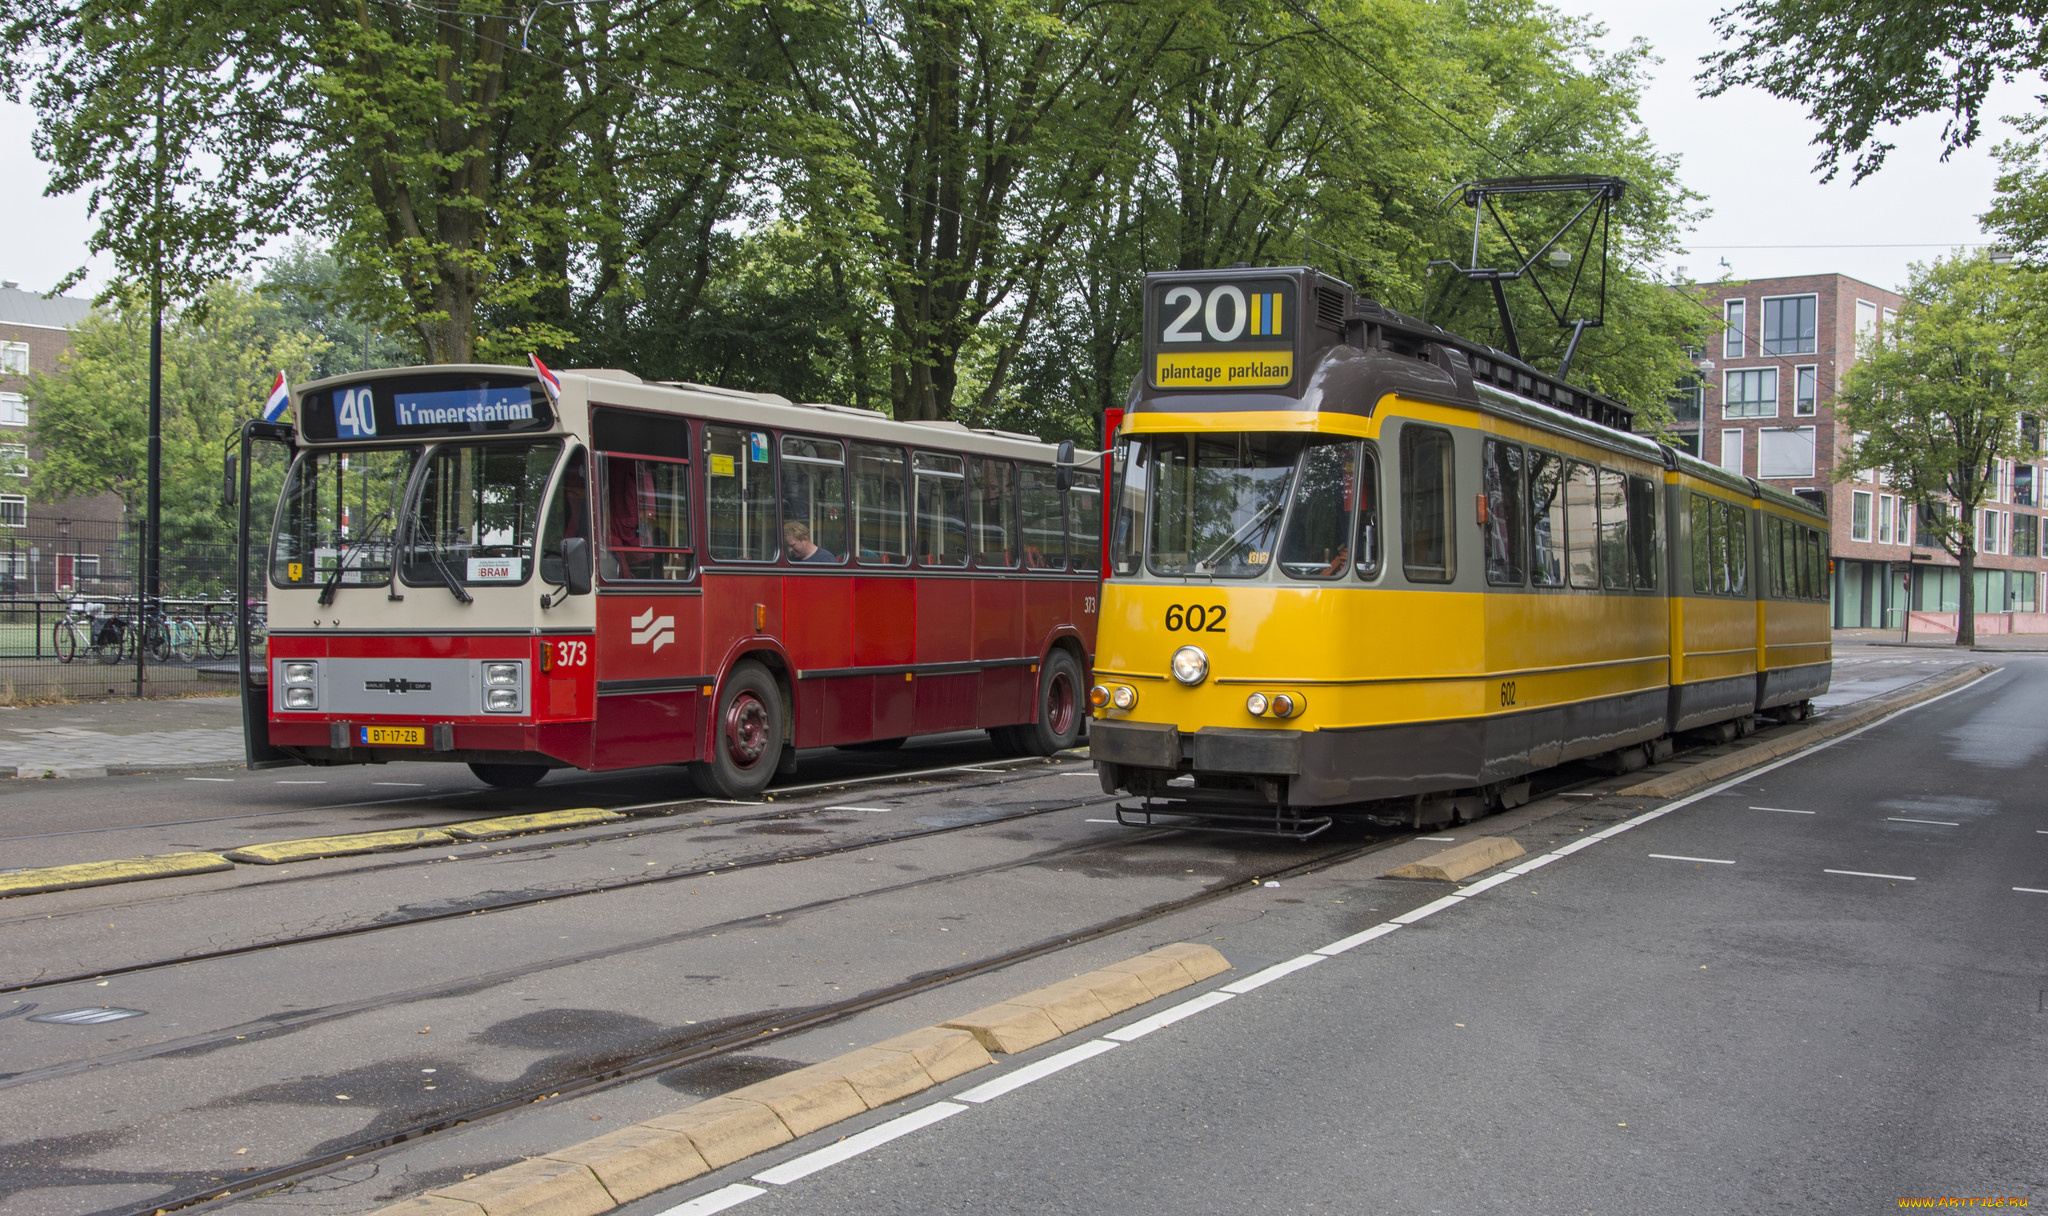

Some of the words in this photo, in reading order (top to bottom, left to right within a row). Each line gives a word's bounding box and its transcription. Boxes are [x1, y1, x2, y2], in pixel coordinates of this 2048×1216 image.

[1163, 285, 1247, 343] 20
[1161, 363, 1222, 383] plantage
[1228, 361, 1289, 381] parklaan
[339, 388, 377, 436] 40
[399, 398, 533, 425] h'meerstation
[293, 564, 298, 575] 2
[480, 567, 509, 577] BRAM
[1084, 596, 1096, 613] 373
[1165, 603, 1227, 633] 602
[557, 640, 587, 667] 373
[1500, 681, 1516, 707] 602
[373, 729, 418, 743] BT-17-ZB
